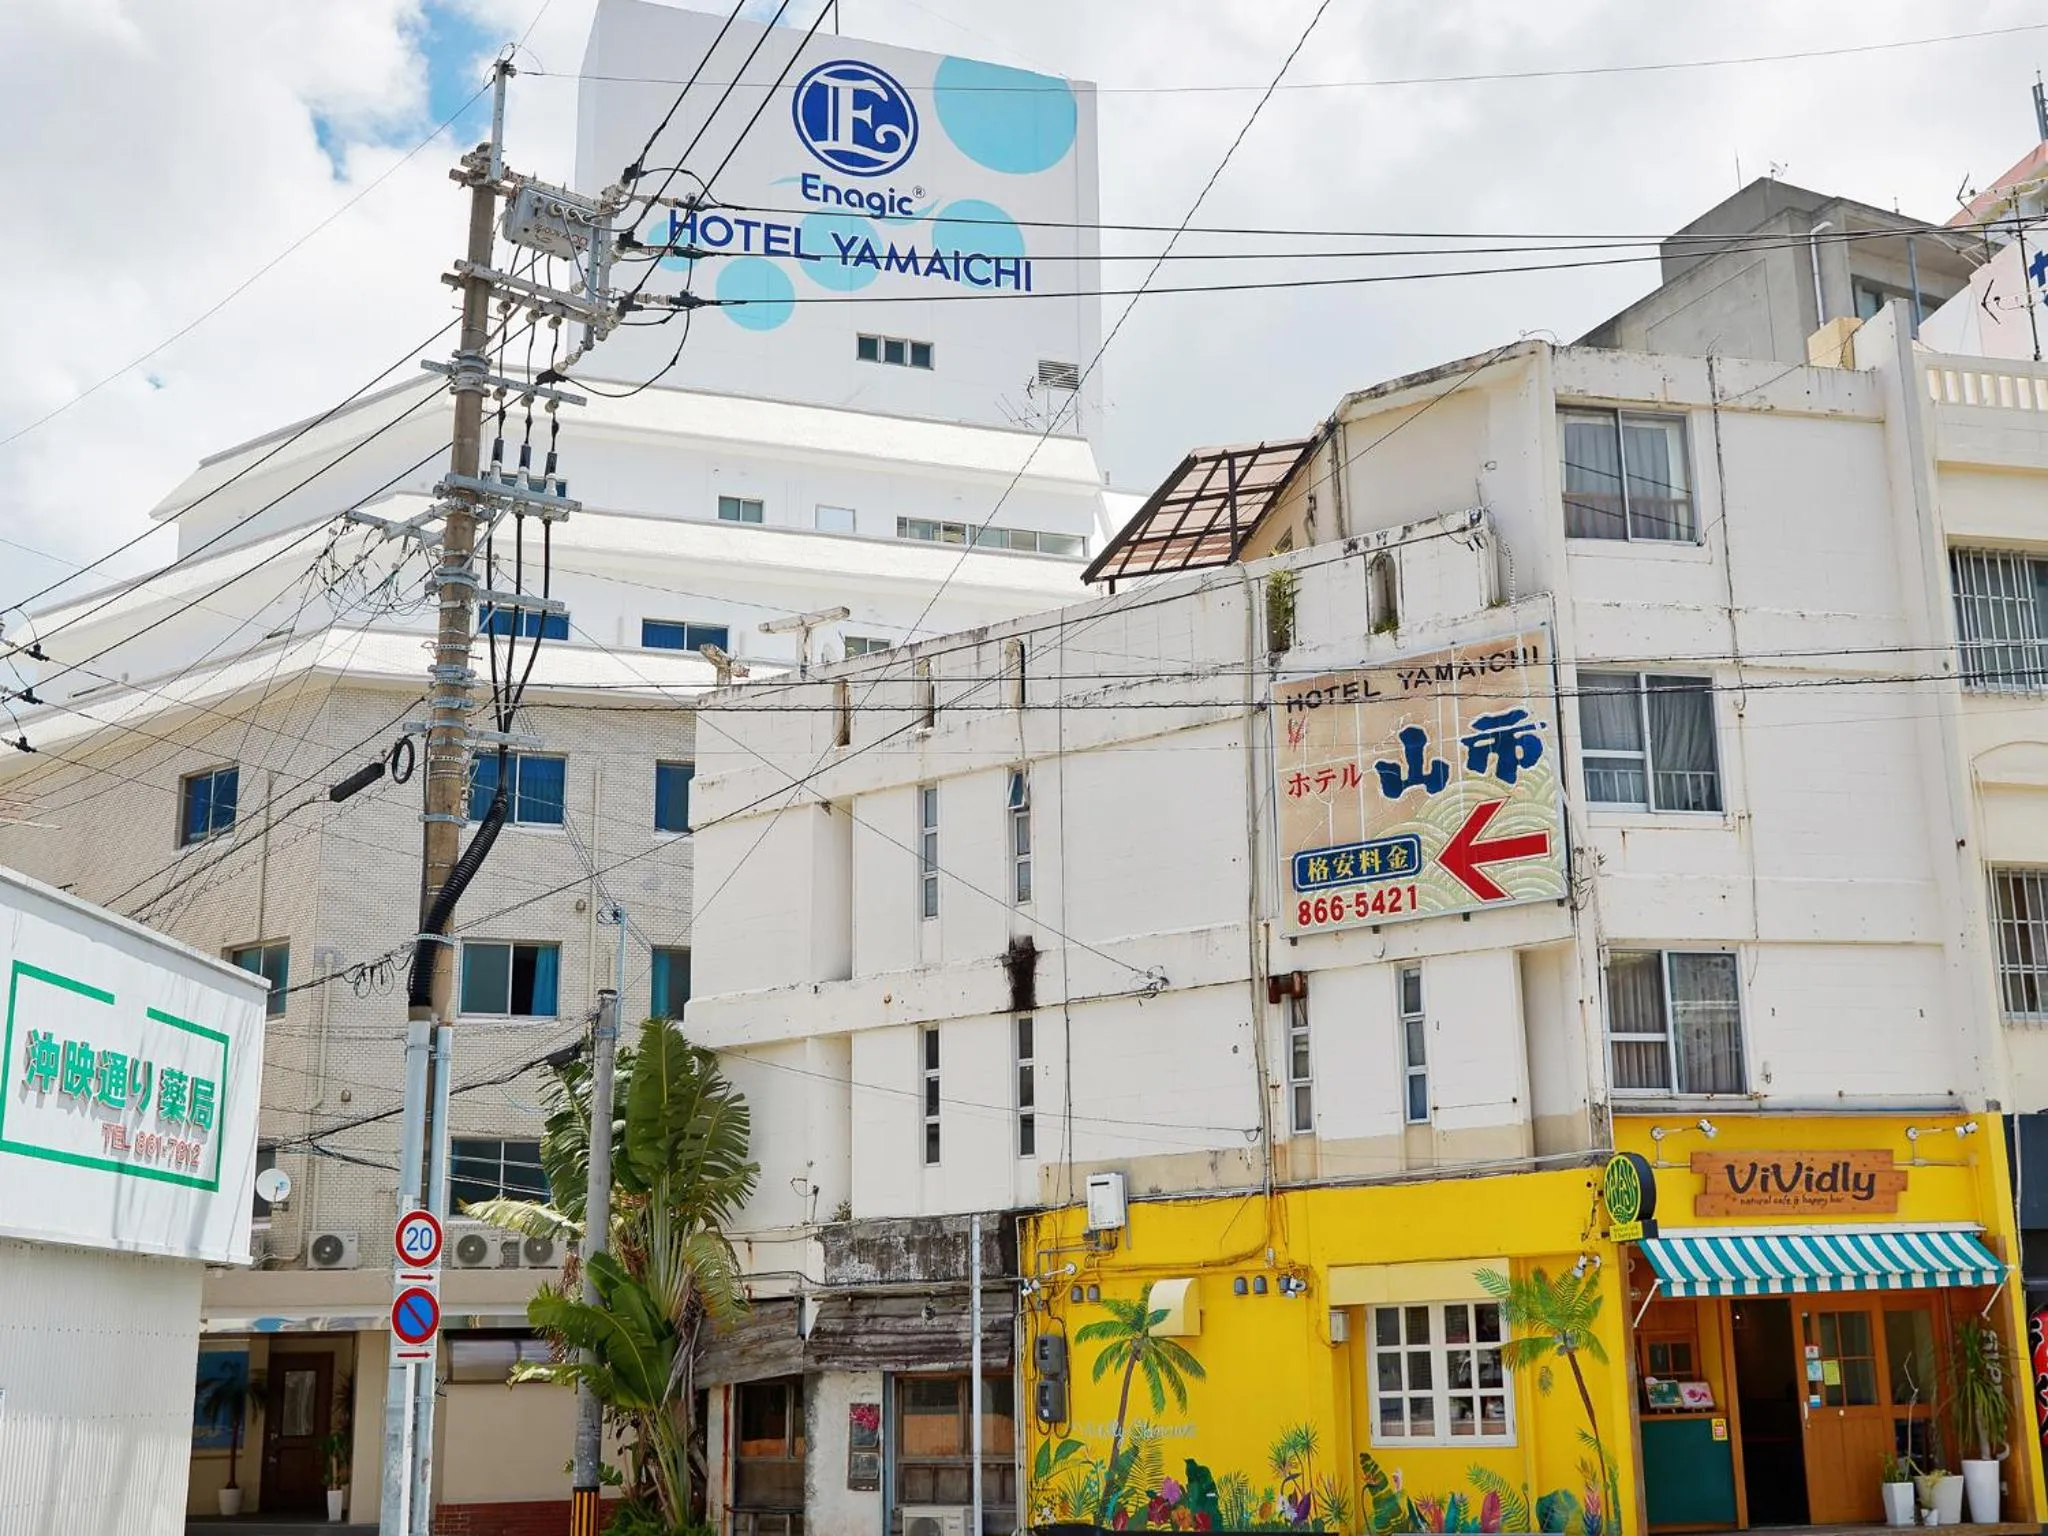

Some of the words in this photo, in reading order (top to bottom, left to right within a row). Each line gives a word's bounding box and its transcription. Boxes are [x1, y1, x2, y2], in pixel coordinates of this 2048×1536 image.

[669, 209, 821, 262] HOTEL
[830, 232, 1033, 292] YAMAICHI
[1287, 680, 1381, 713] HOTEL
[1396, 646, 1539, 691] YAMAICHI
[1287, 763, 1363, 799] ホテル
[1374, 709, 1548, 799] 山市
[1307, 844, 1410, 883] 格安料金
[1297, 884, 1418, 926] 866-5421
[1724, 1161, 1877, 1202] ViVidly
[406, 1226, 433, 1251] 20
